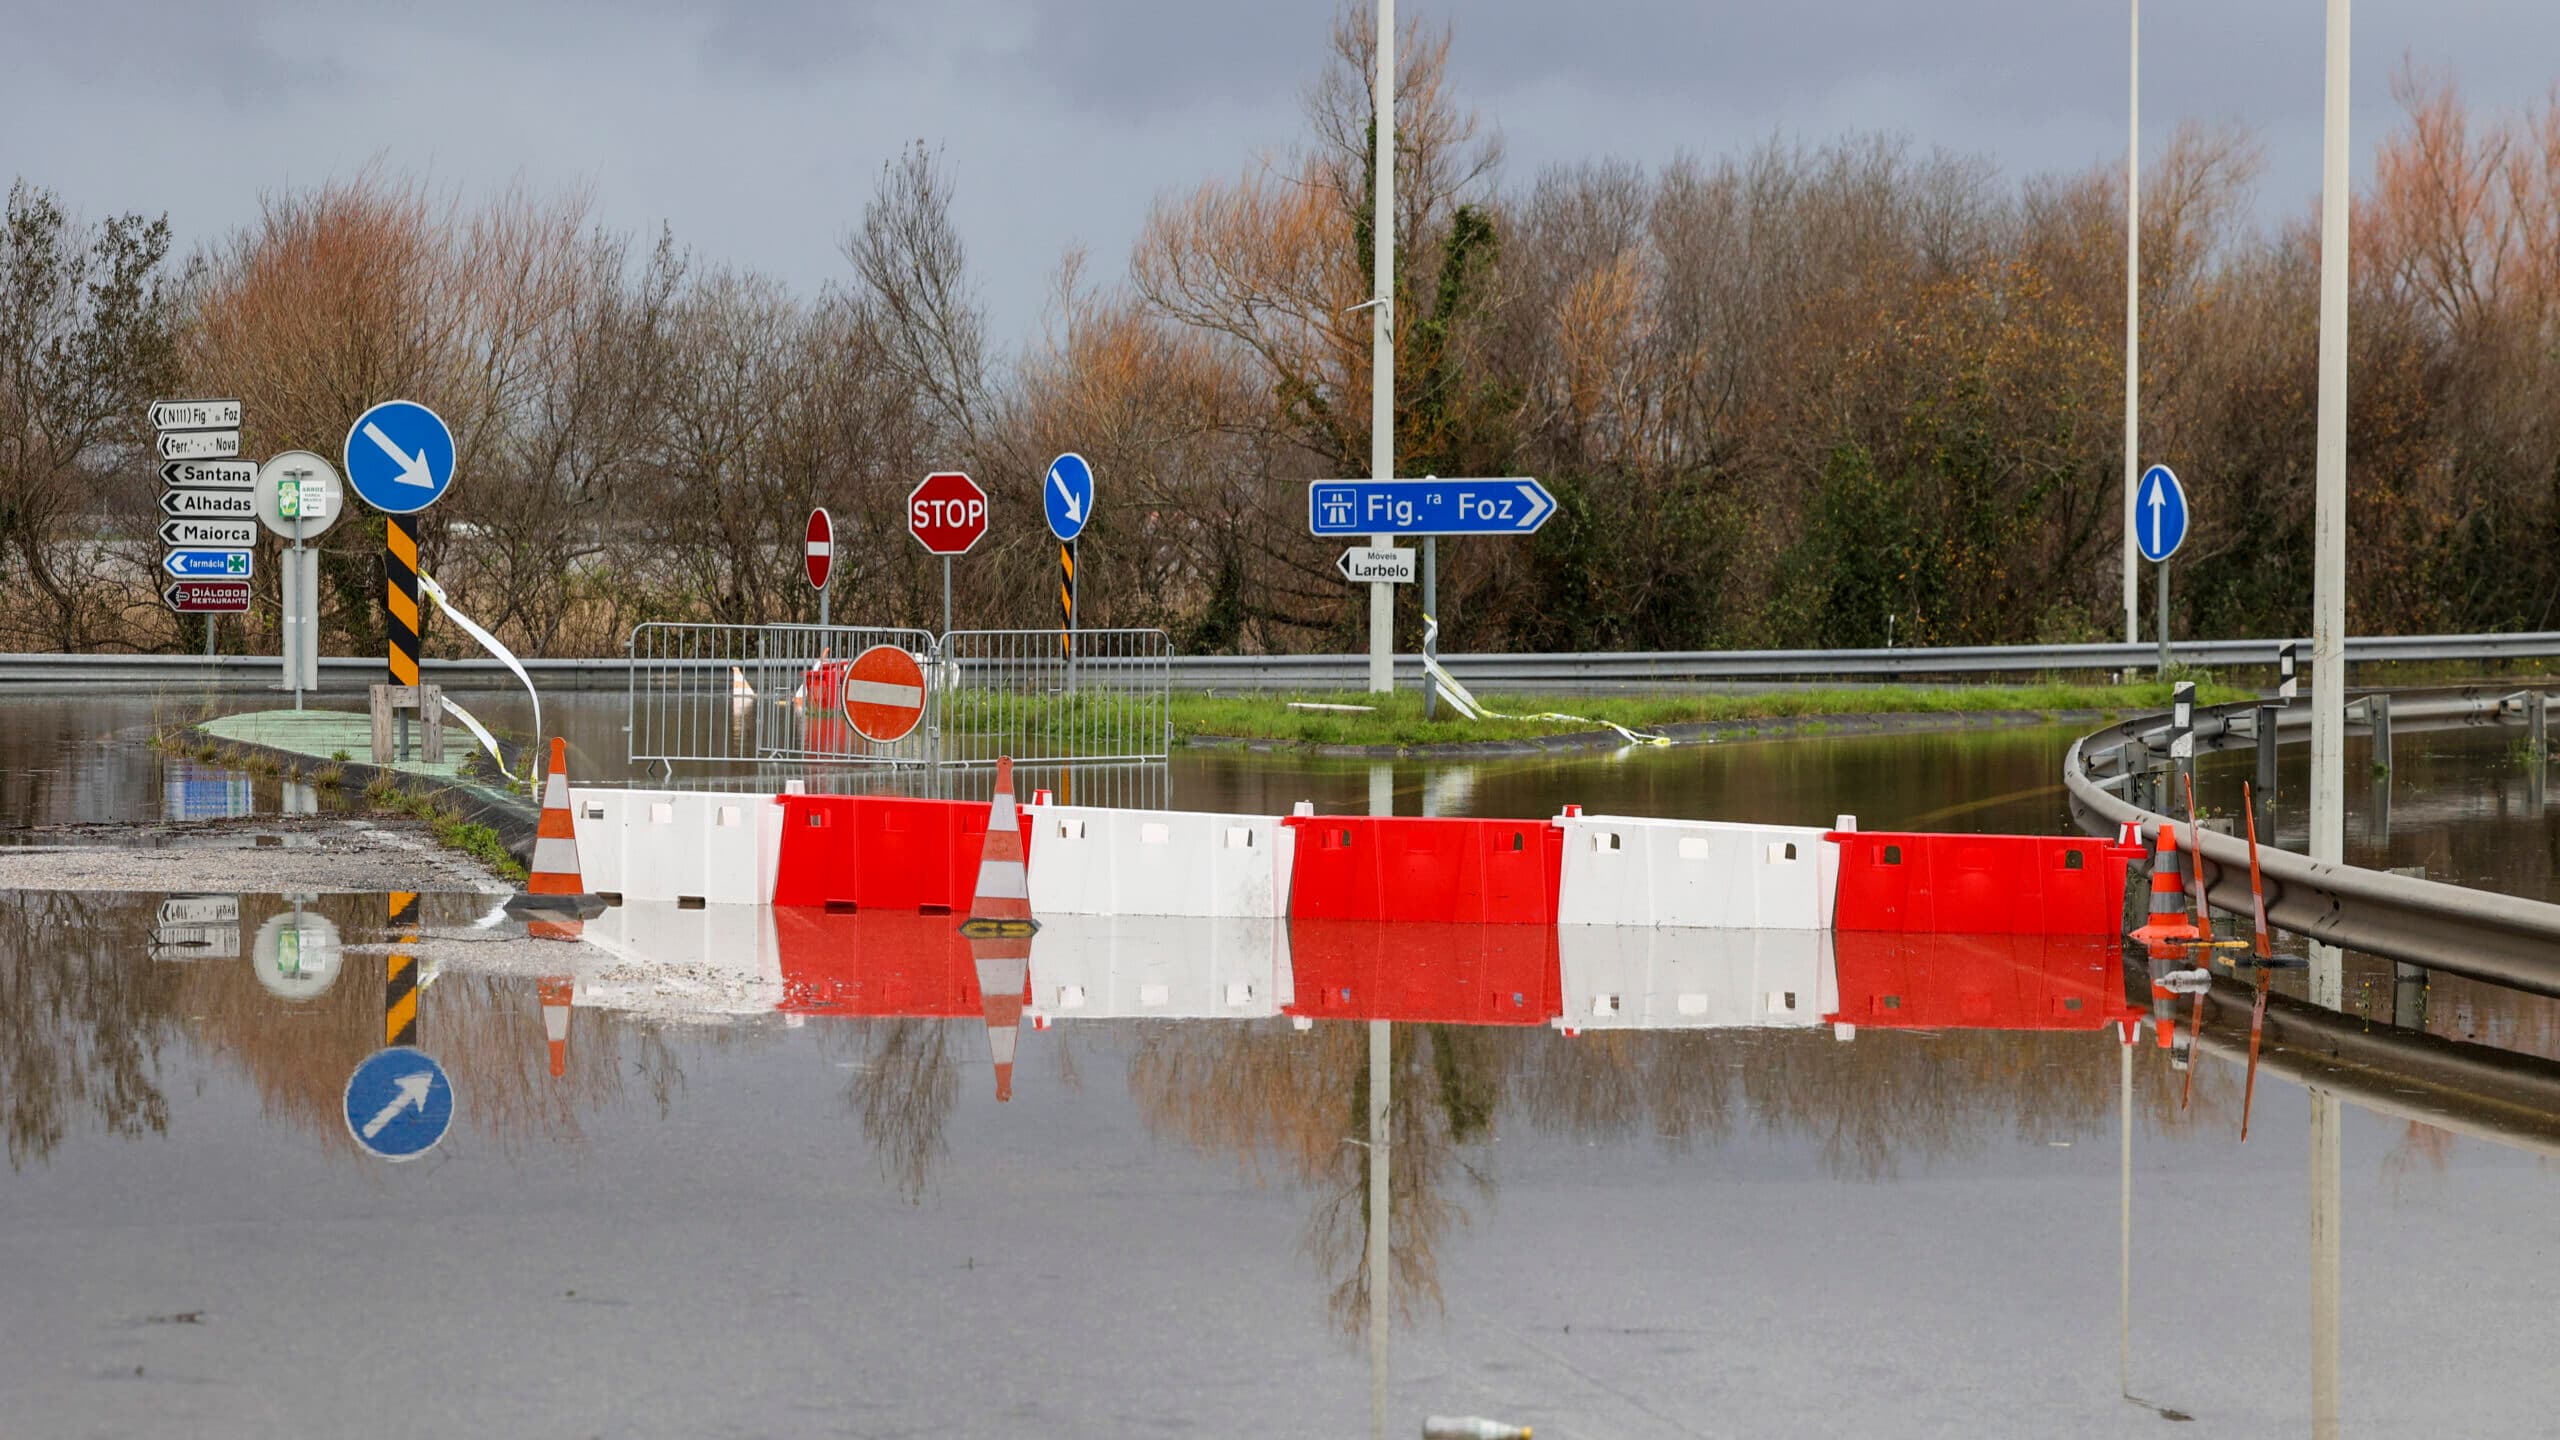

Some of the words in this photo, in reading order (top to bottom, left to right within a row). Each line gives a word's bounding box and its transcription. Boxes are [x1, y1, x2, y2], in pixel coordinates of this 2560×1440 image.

[224, 407, 238, 421] Foz
[216, 437, 236, 452] Nova
[184, 466, 251, 482] Santana
[184, 496, 251, 511] Alhadas
[1459, 493, 1513, 520] Foz
[913, 498, 984, 529] STOP
[184, 526, 250, 540] Maiorca
[189, 558, 225, 569] farmácia
[1367, 552, 1398, 561] Móveis
[1355, 563, 1409, 577] Larbelo
[191, 597, 247, 605] RESTAURANTE
